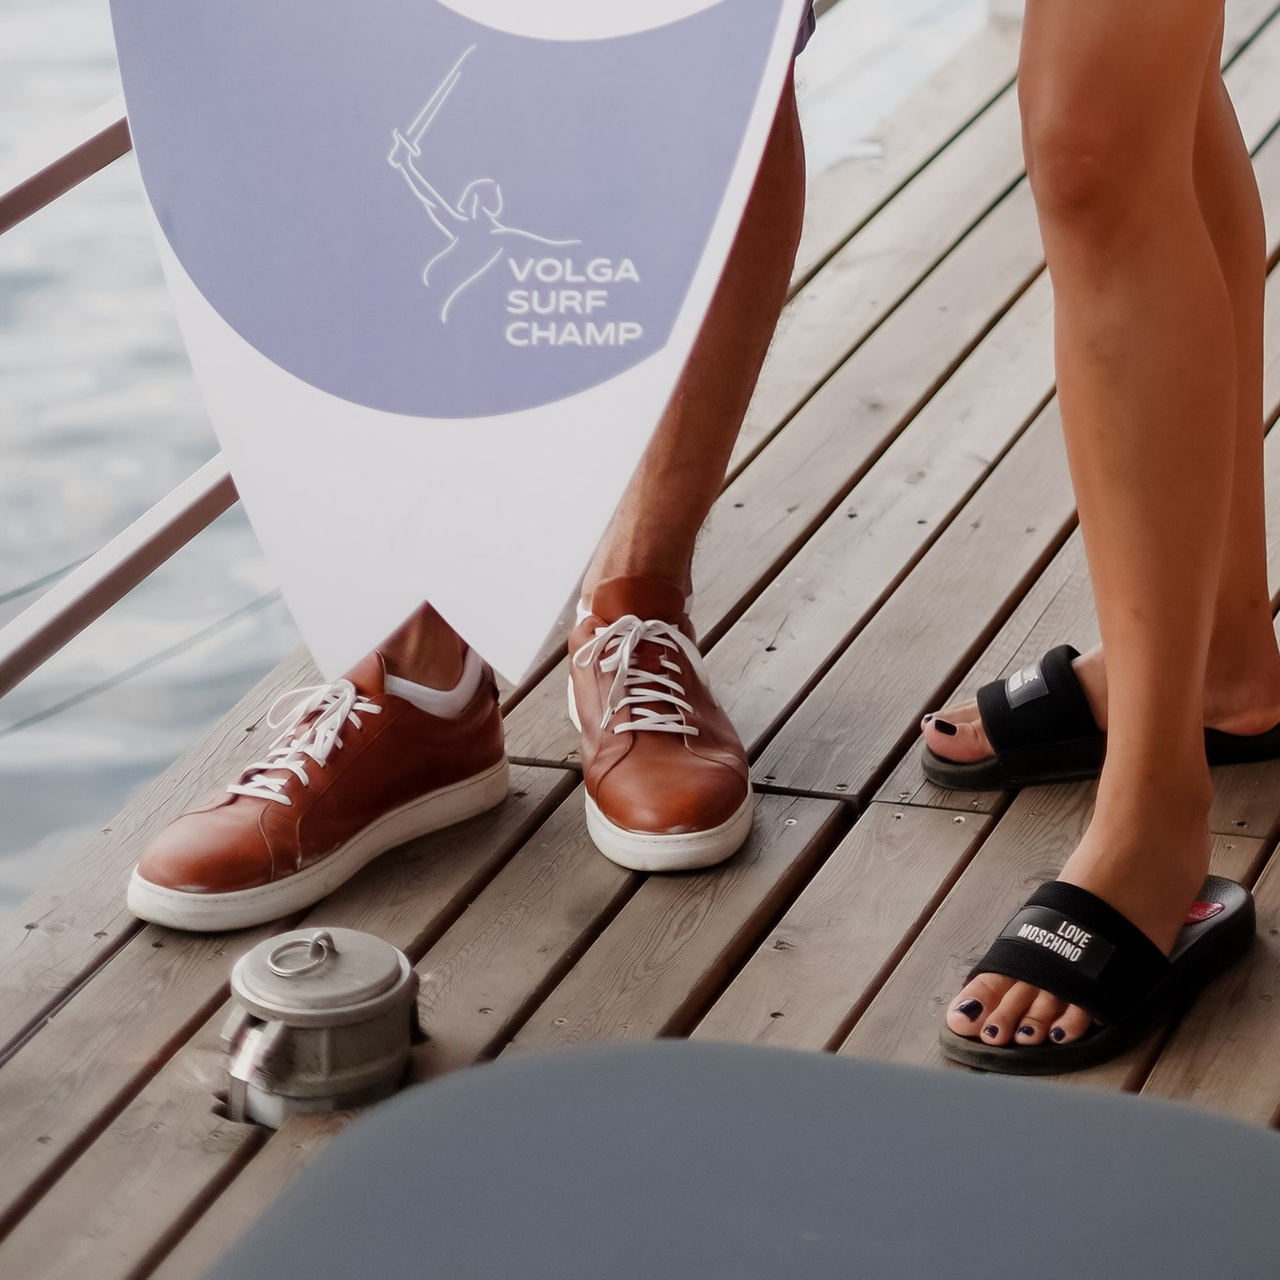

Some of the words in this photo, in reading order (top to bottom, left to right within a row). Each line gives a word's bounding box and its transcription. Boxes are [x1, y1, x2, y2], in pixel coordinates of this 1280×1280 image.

[507, 257, 641, 283] VOLGA
[505, 289, 609, 315] SURF
[505, 321, 643, 347] CHAMP
[1017, 923, 1082, 962] MOSCHINO
[1056, 920, 1092, 949] LOVE
